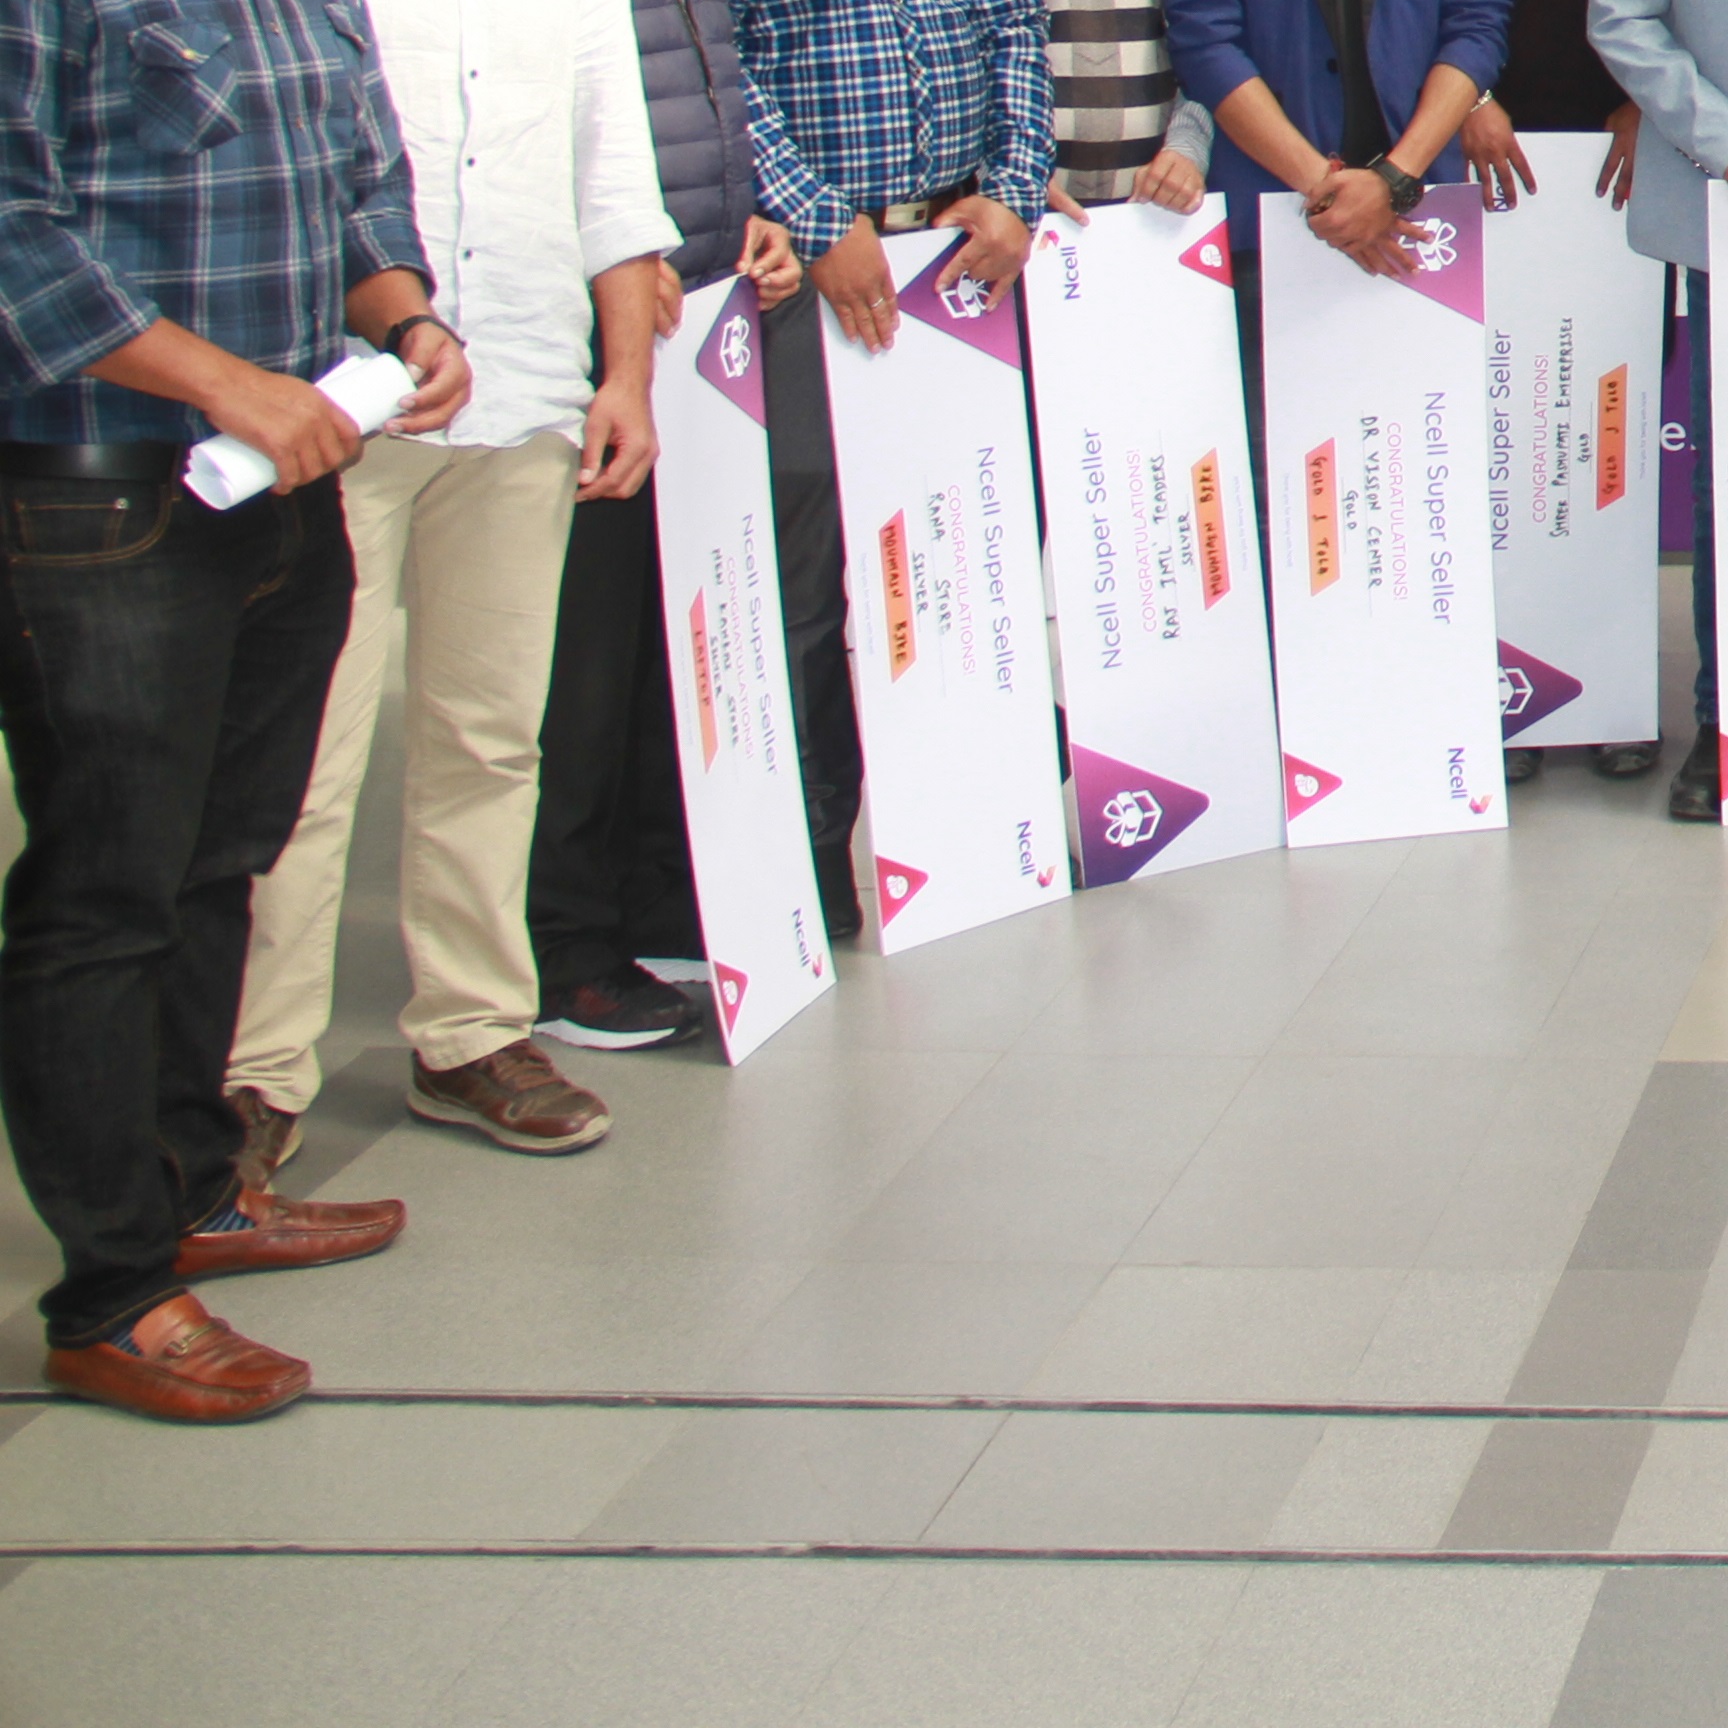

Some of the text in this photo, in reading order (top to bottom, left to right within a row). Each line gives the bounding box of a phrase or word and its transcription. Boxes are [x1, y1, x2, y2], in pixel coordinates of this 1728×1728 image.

[1059, 246, 1080, 300] Ncell
[928, 492, 945, 542] RANA
[1342, 490, 1358, 531] GOLD
[1360, 416, 1382, 590] DR VISION CENTER
[1386, 422, 1408, 600] CONGRATULATIONS!
[1423, 392, 1454, 624] Ncell Super Seller
[1488, 328, 1514, 551] Ncell Super Seller
[1532, 355, 1548, 523] CONGRATULATIONS!
[948, 484, 976, 675] CONGRATULATIONS!
[977, 446, 1015, 693] Ncell Super Seller
[1081, 428, 1123, 670] Ncell Super Seller
[1127, 448, 1157, 632] CONGRATULATIONS!
[727, 557, 754, 759] CONGRATULATIONS!
[742, 513, 777, 774] Ncell Super Seller
[1017, 820, 1037, 876] Ncell
[1448, 747, 1469, 799] Ncell
[793, 907, 811, 968] Ncell
